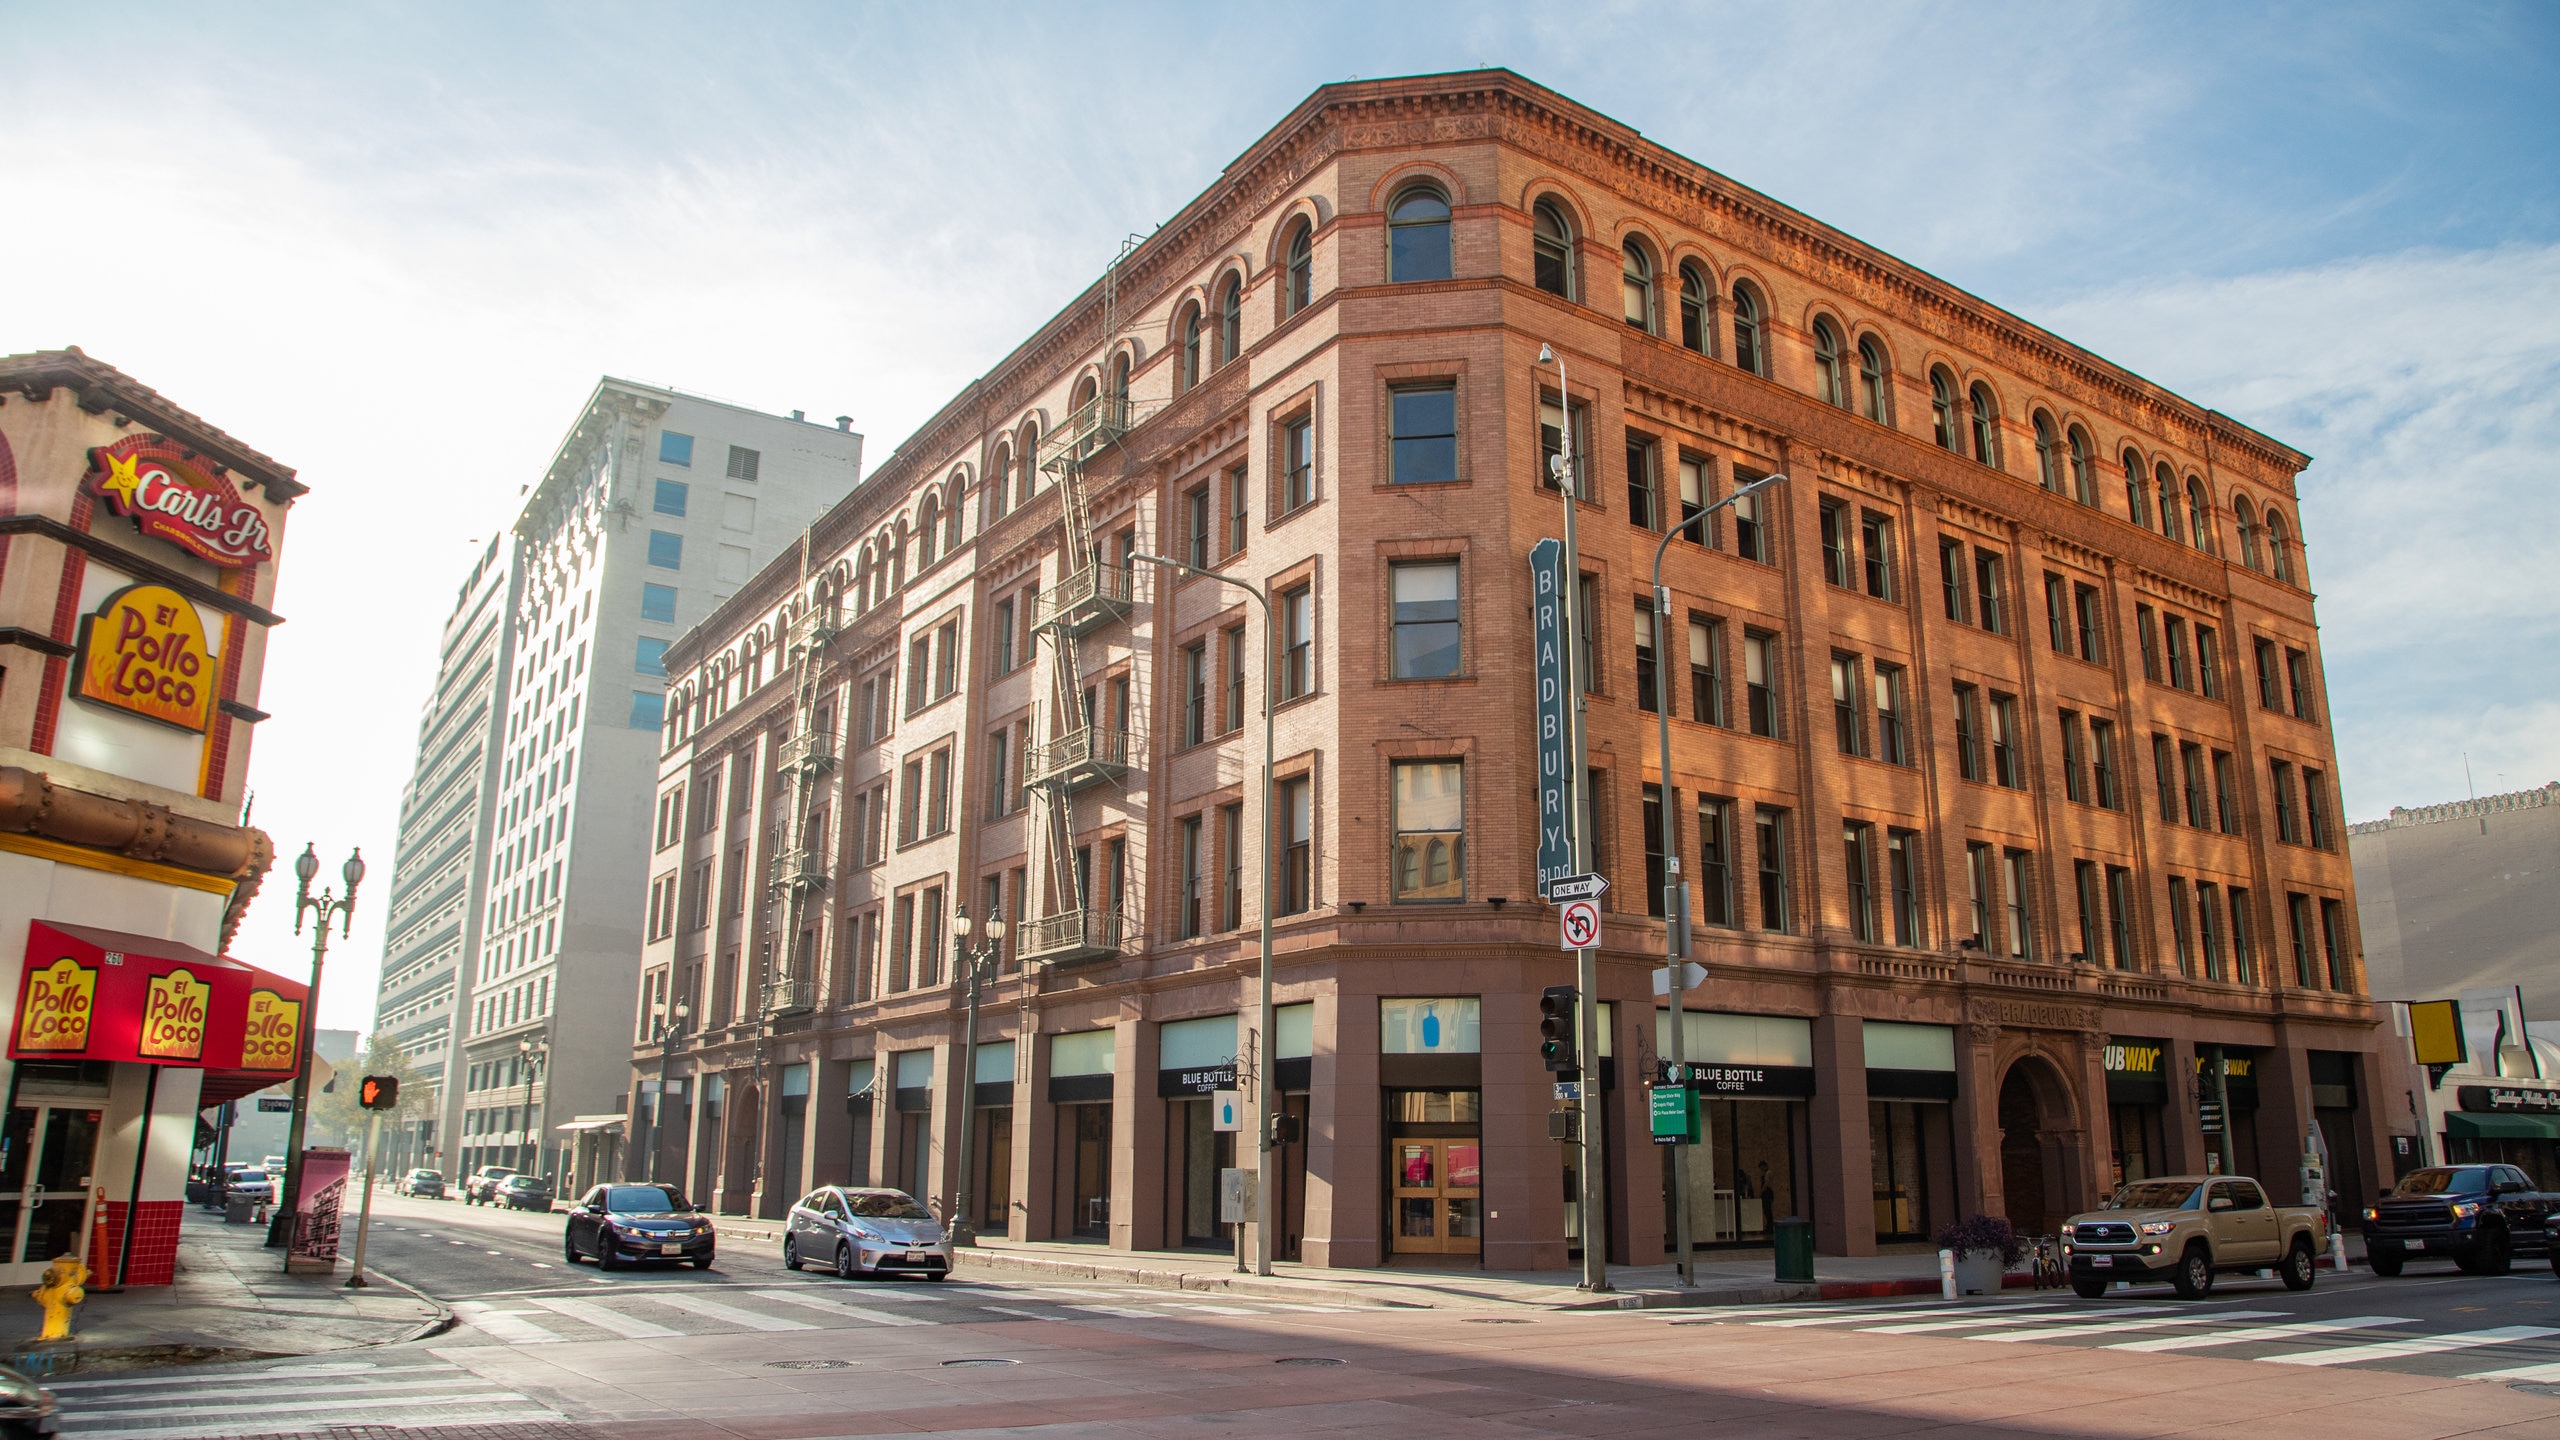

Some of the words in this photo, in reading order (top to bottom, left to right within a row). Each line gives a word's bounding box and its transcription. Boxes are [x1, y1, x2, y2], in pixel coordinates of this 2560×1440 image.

[136, 470, 225, 531] Carl's
[154, 603, 178, 628] El
[115, 605, 200, 677] Pollo
[113, 651, 196, 707] Loco
[1538, 568, 1560, 853] BRADBURY
[1555, 884, 1571, 896] ONE
[1573, 882, 1590, 893] WAY
[105, 952, 123, 964] 260
[56, 969, 73, 984] El
[173, 980, 189, 995] El
[30, 980, 89, 1014] Pollo
[150, 987, 203, 1024] Pollo
[254, 1000, 273, 1013] El
[29, 1008, 86, 1038] Loco
[246, 1013, 293, 1039] ollo
[2000, 1002, 2075, 1026] BRADBURY
[150, 1016, 201, 1045] Loco
[244, 1039, 293, 1056] oco
[2103, 1045, 2161, 1072] UBWAY
[1182, 1072, 1201, 1084] BLUE
[1203, 1071, 1232, 1083] BOTTLE
[1695, 1068, 1722, 1080] BLUE
[1724, 1069, 1764, 1082] BOTTLE
[2223, 1058, 2251, 1076] BWAY
[1573, 1083, 1580, 1093] St
[1716, 1081, 1745, 1091] COFFEE
